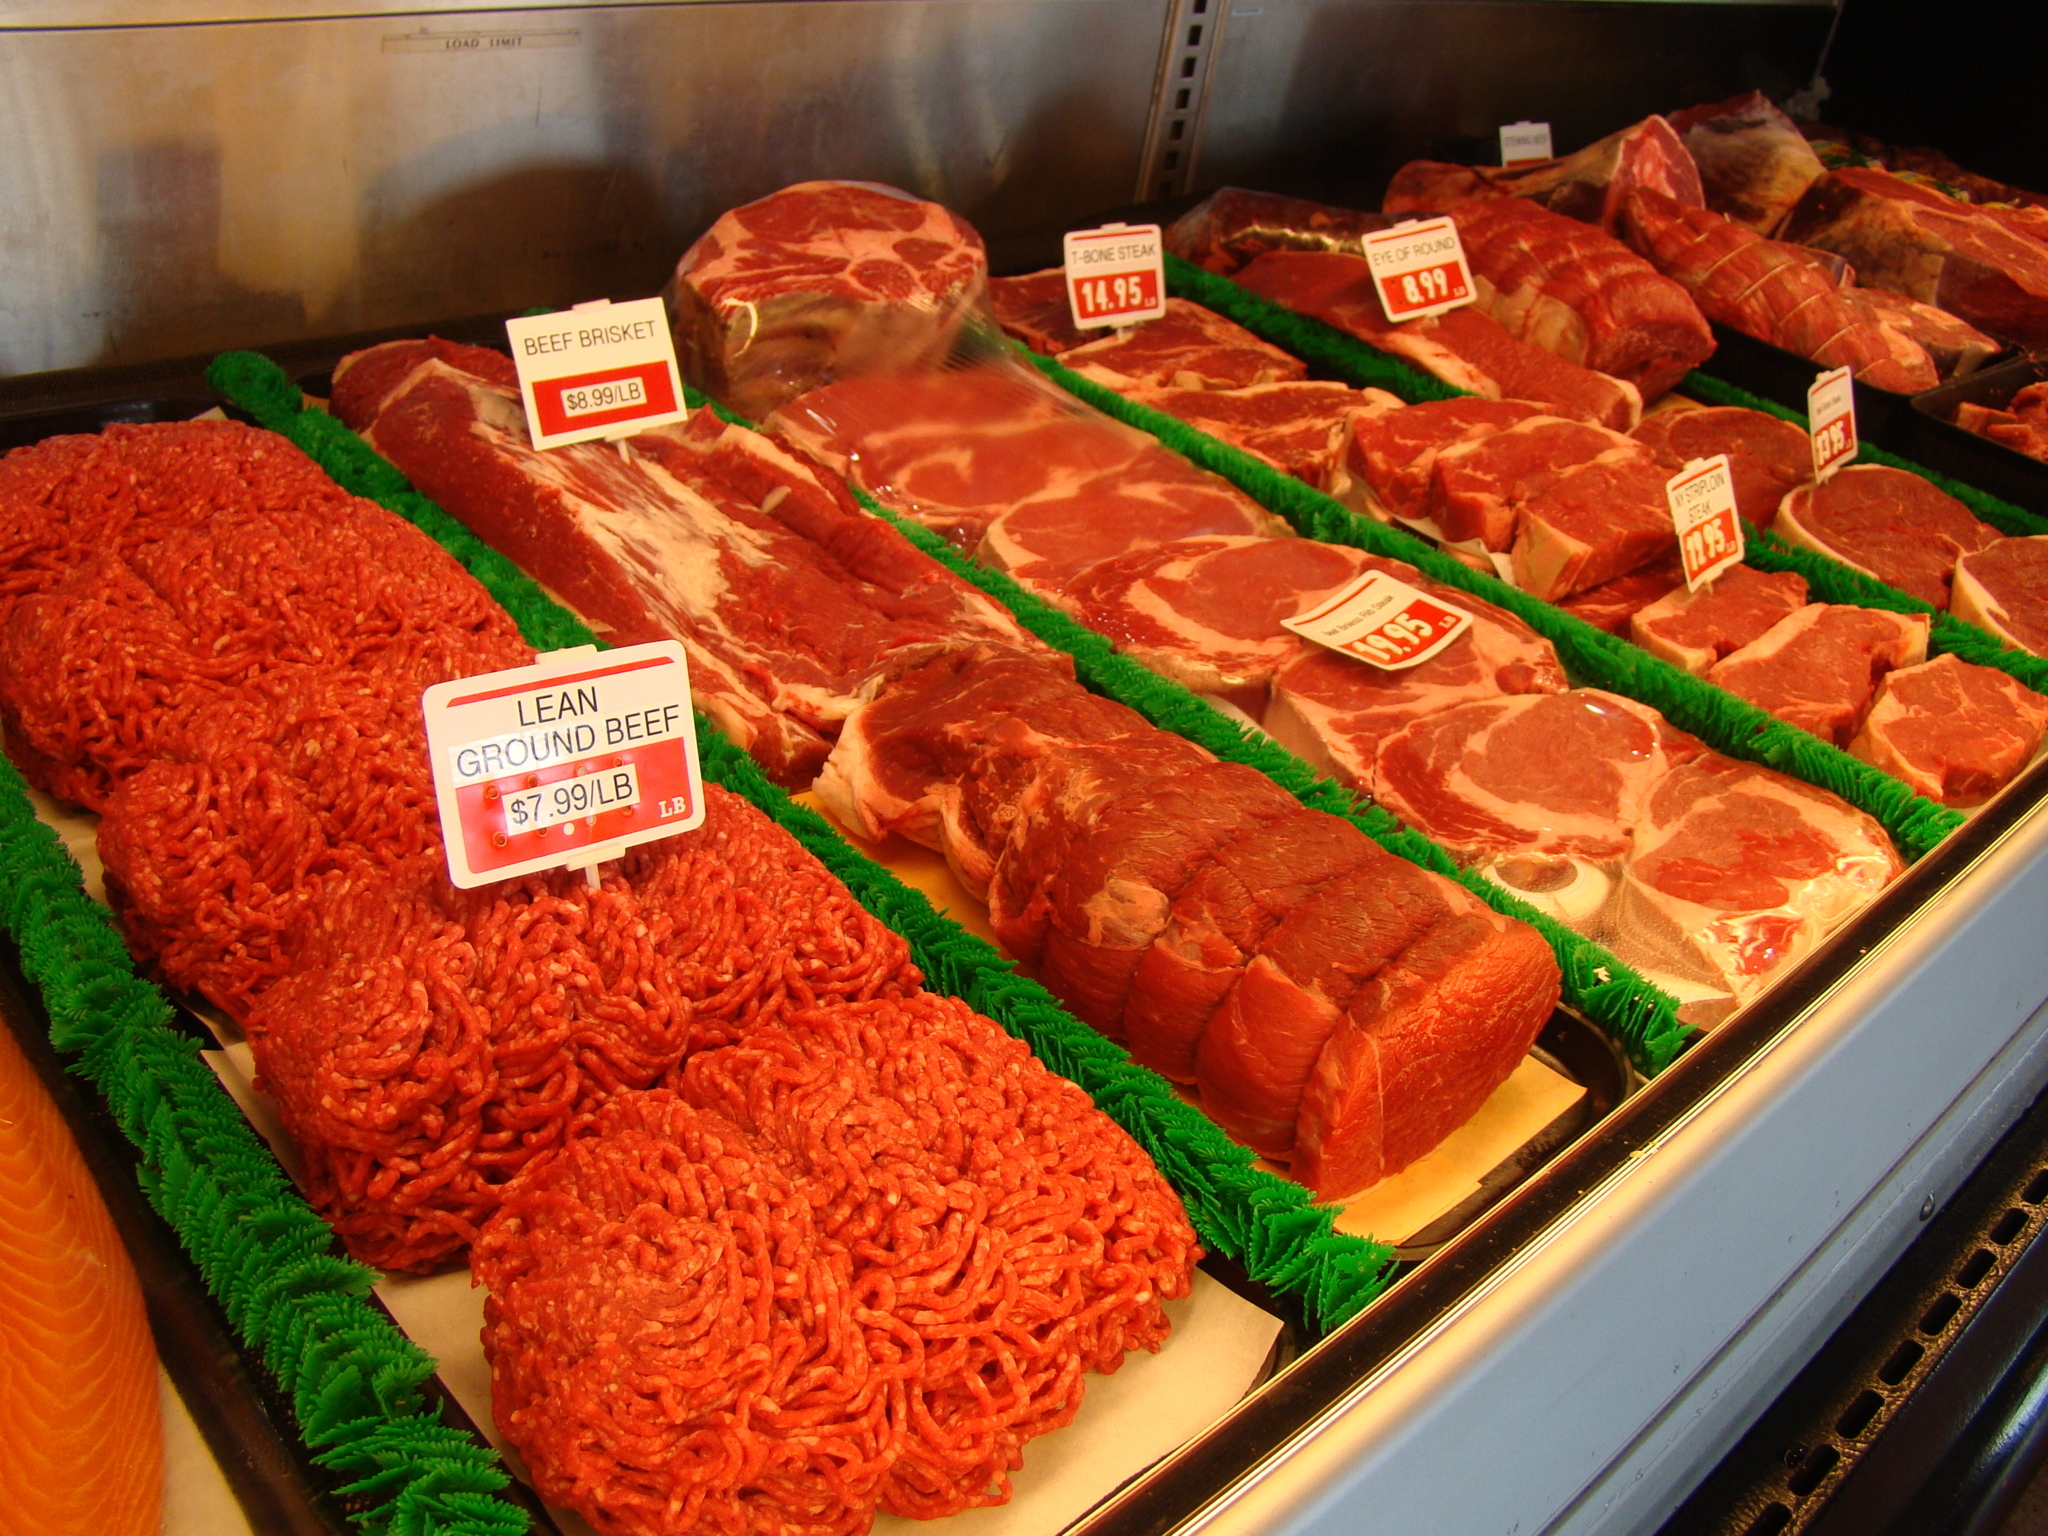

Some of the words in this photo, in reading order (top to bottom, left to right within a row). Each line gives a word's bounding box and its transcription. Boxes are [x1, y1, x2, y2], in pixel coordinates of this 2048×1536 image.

[446, 38, 479, 49] LOAD
[490, 37, 523, 48] LIMIT
[1071, 247, 1115, 264] T-BONE
[1118, 243, 1156, 260] STEAK
[1371, 250, 1395, 266] EYE
[1395, 246, 1411, 261] OF
[1413, 236, 1456, 256] ROUND
[1081, 275, 1142, 313] 14.95
[1402, 267, 1448, 304] 8.99
[524, 332, 573, 356] BEEF
[579, 320, 655, 348] BRISKET
[566, 382, 641, 411] $8.99/LB
[1351, 612, 1433, 661] 19.95
[517, 686, 599, 727] LEAN
[456, 724, 596, 778] GROUND
[605, 704, 680, 746] BEEF
[510, 773, 633, 825] $7.99/LB
[658, 796, 687, 819] LB
